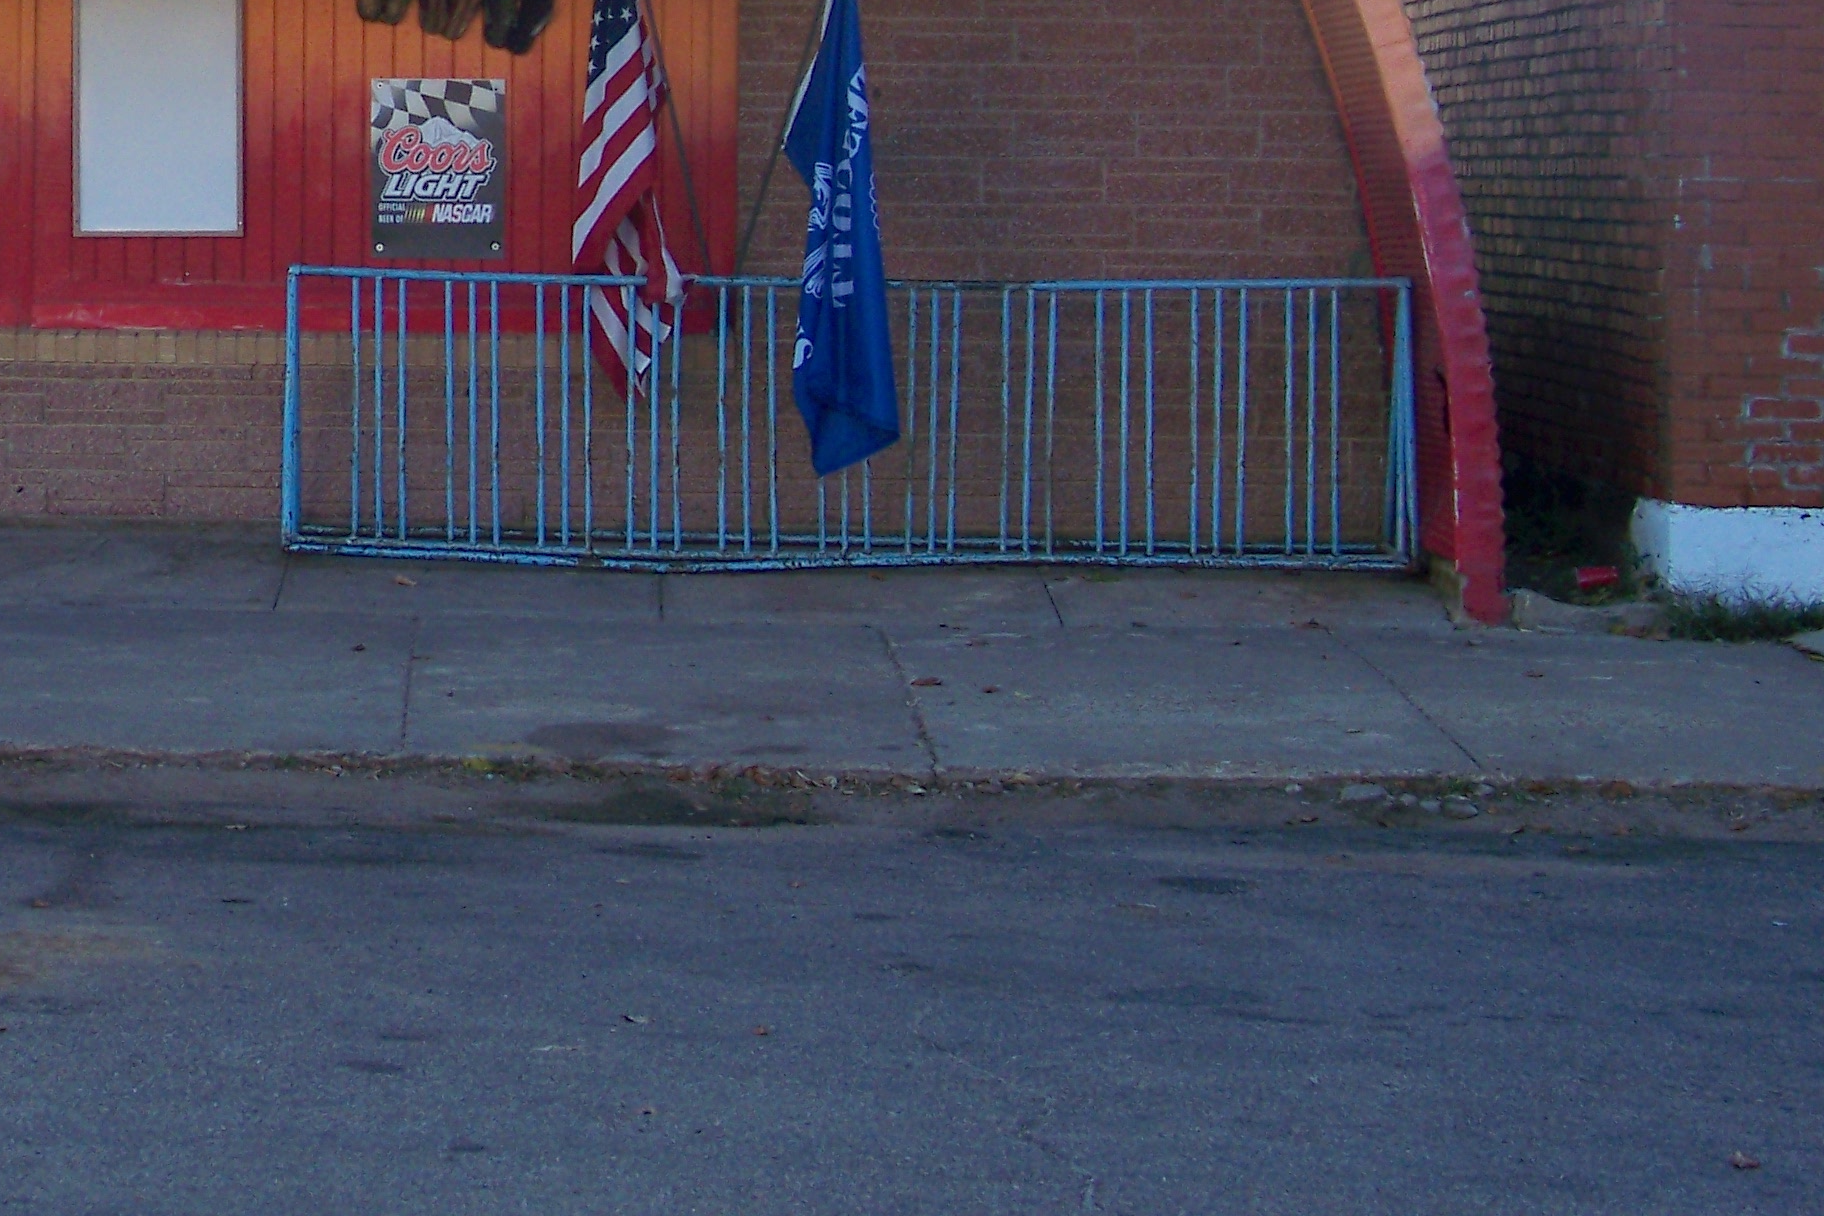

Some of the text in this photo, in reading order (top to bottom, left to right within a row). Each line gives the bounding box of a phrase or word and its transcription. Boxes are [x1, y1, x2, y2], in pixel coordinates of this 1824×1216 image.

[380, 124, 497, 174] Coors
[381, 171, 489, 202] LIGHT
[431, 203, 494, 223] NASCAR
